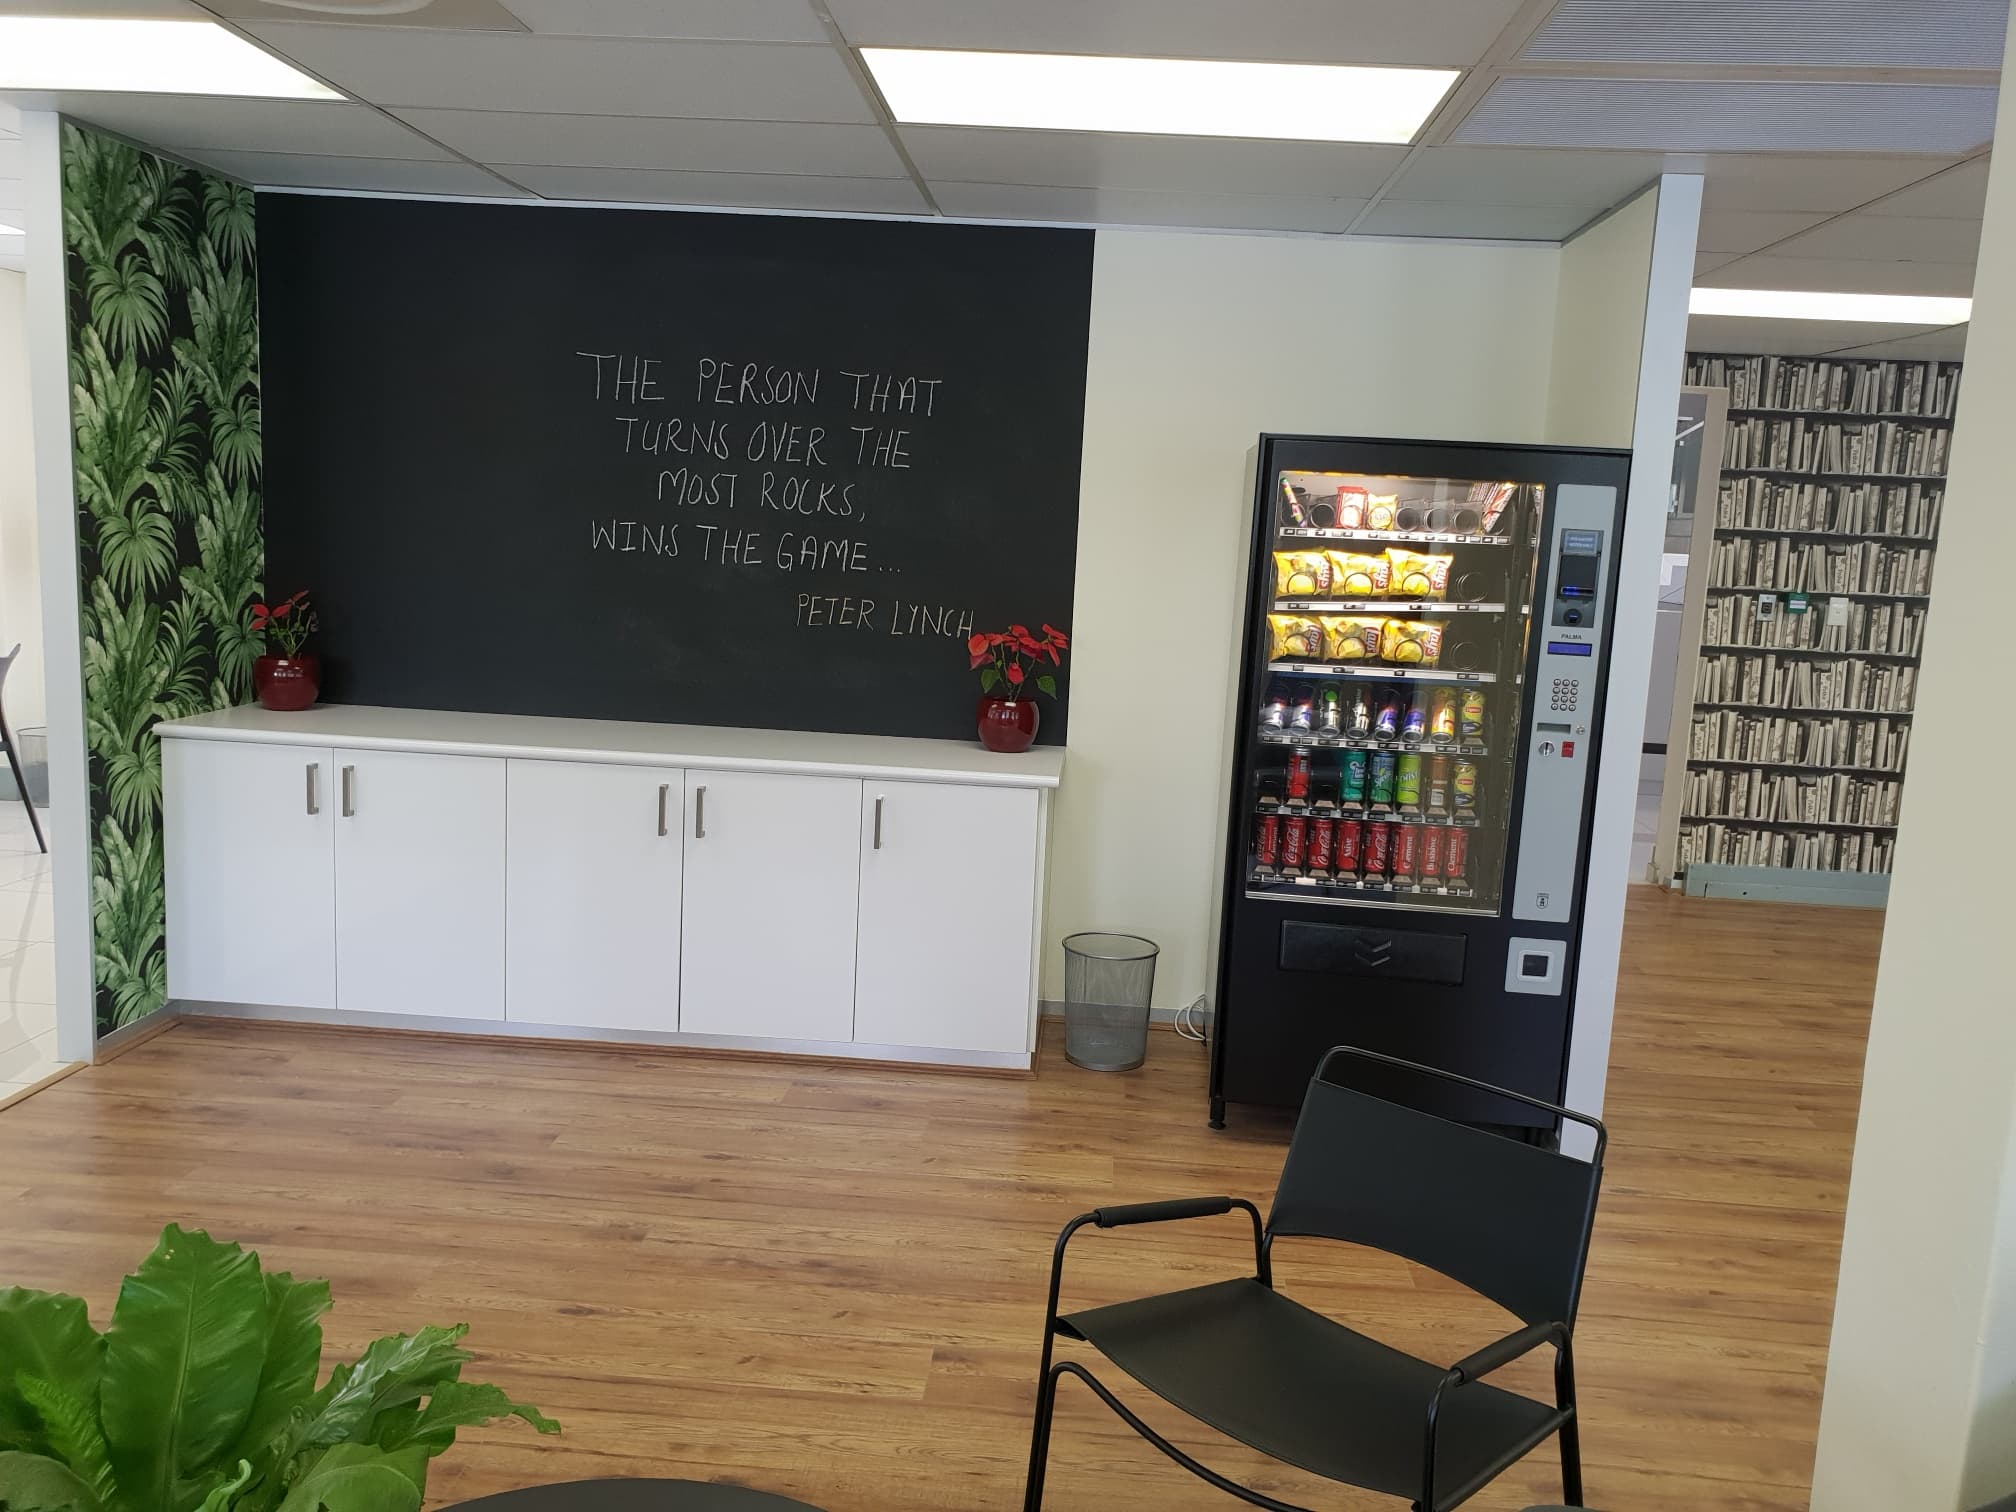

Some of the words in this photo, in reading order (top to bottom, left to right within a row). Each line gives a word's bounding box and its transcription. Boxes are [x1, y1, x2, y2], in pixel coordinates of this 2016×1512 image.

[576, 351, 665, 405] THE
[697, 358, 819, 405] PERSON
[839, 371, 943, 417] THAT
[615, 417, 729, 460] TURNS
[747, 421, 827, 467] OVER
[850, 426, 911, 468] THE
[658, 467, 738, 508] MOST
[760, 471, 865, 522] ROCKS,
[592, 519, 679, 557] WINS
[695, 524, 762, 565] THE
[796, 593, 875, 630] PETER
[890, 600, 974, 641] LYNCH
